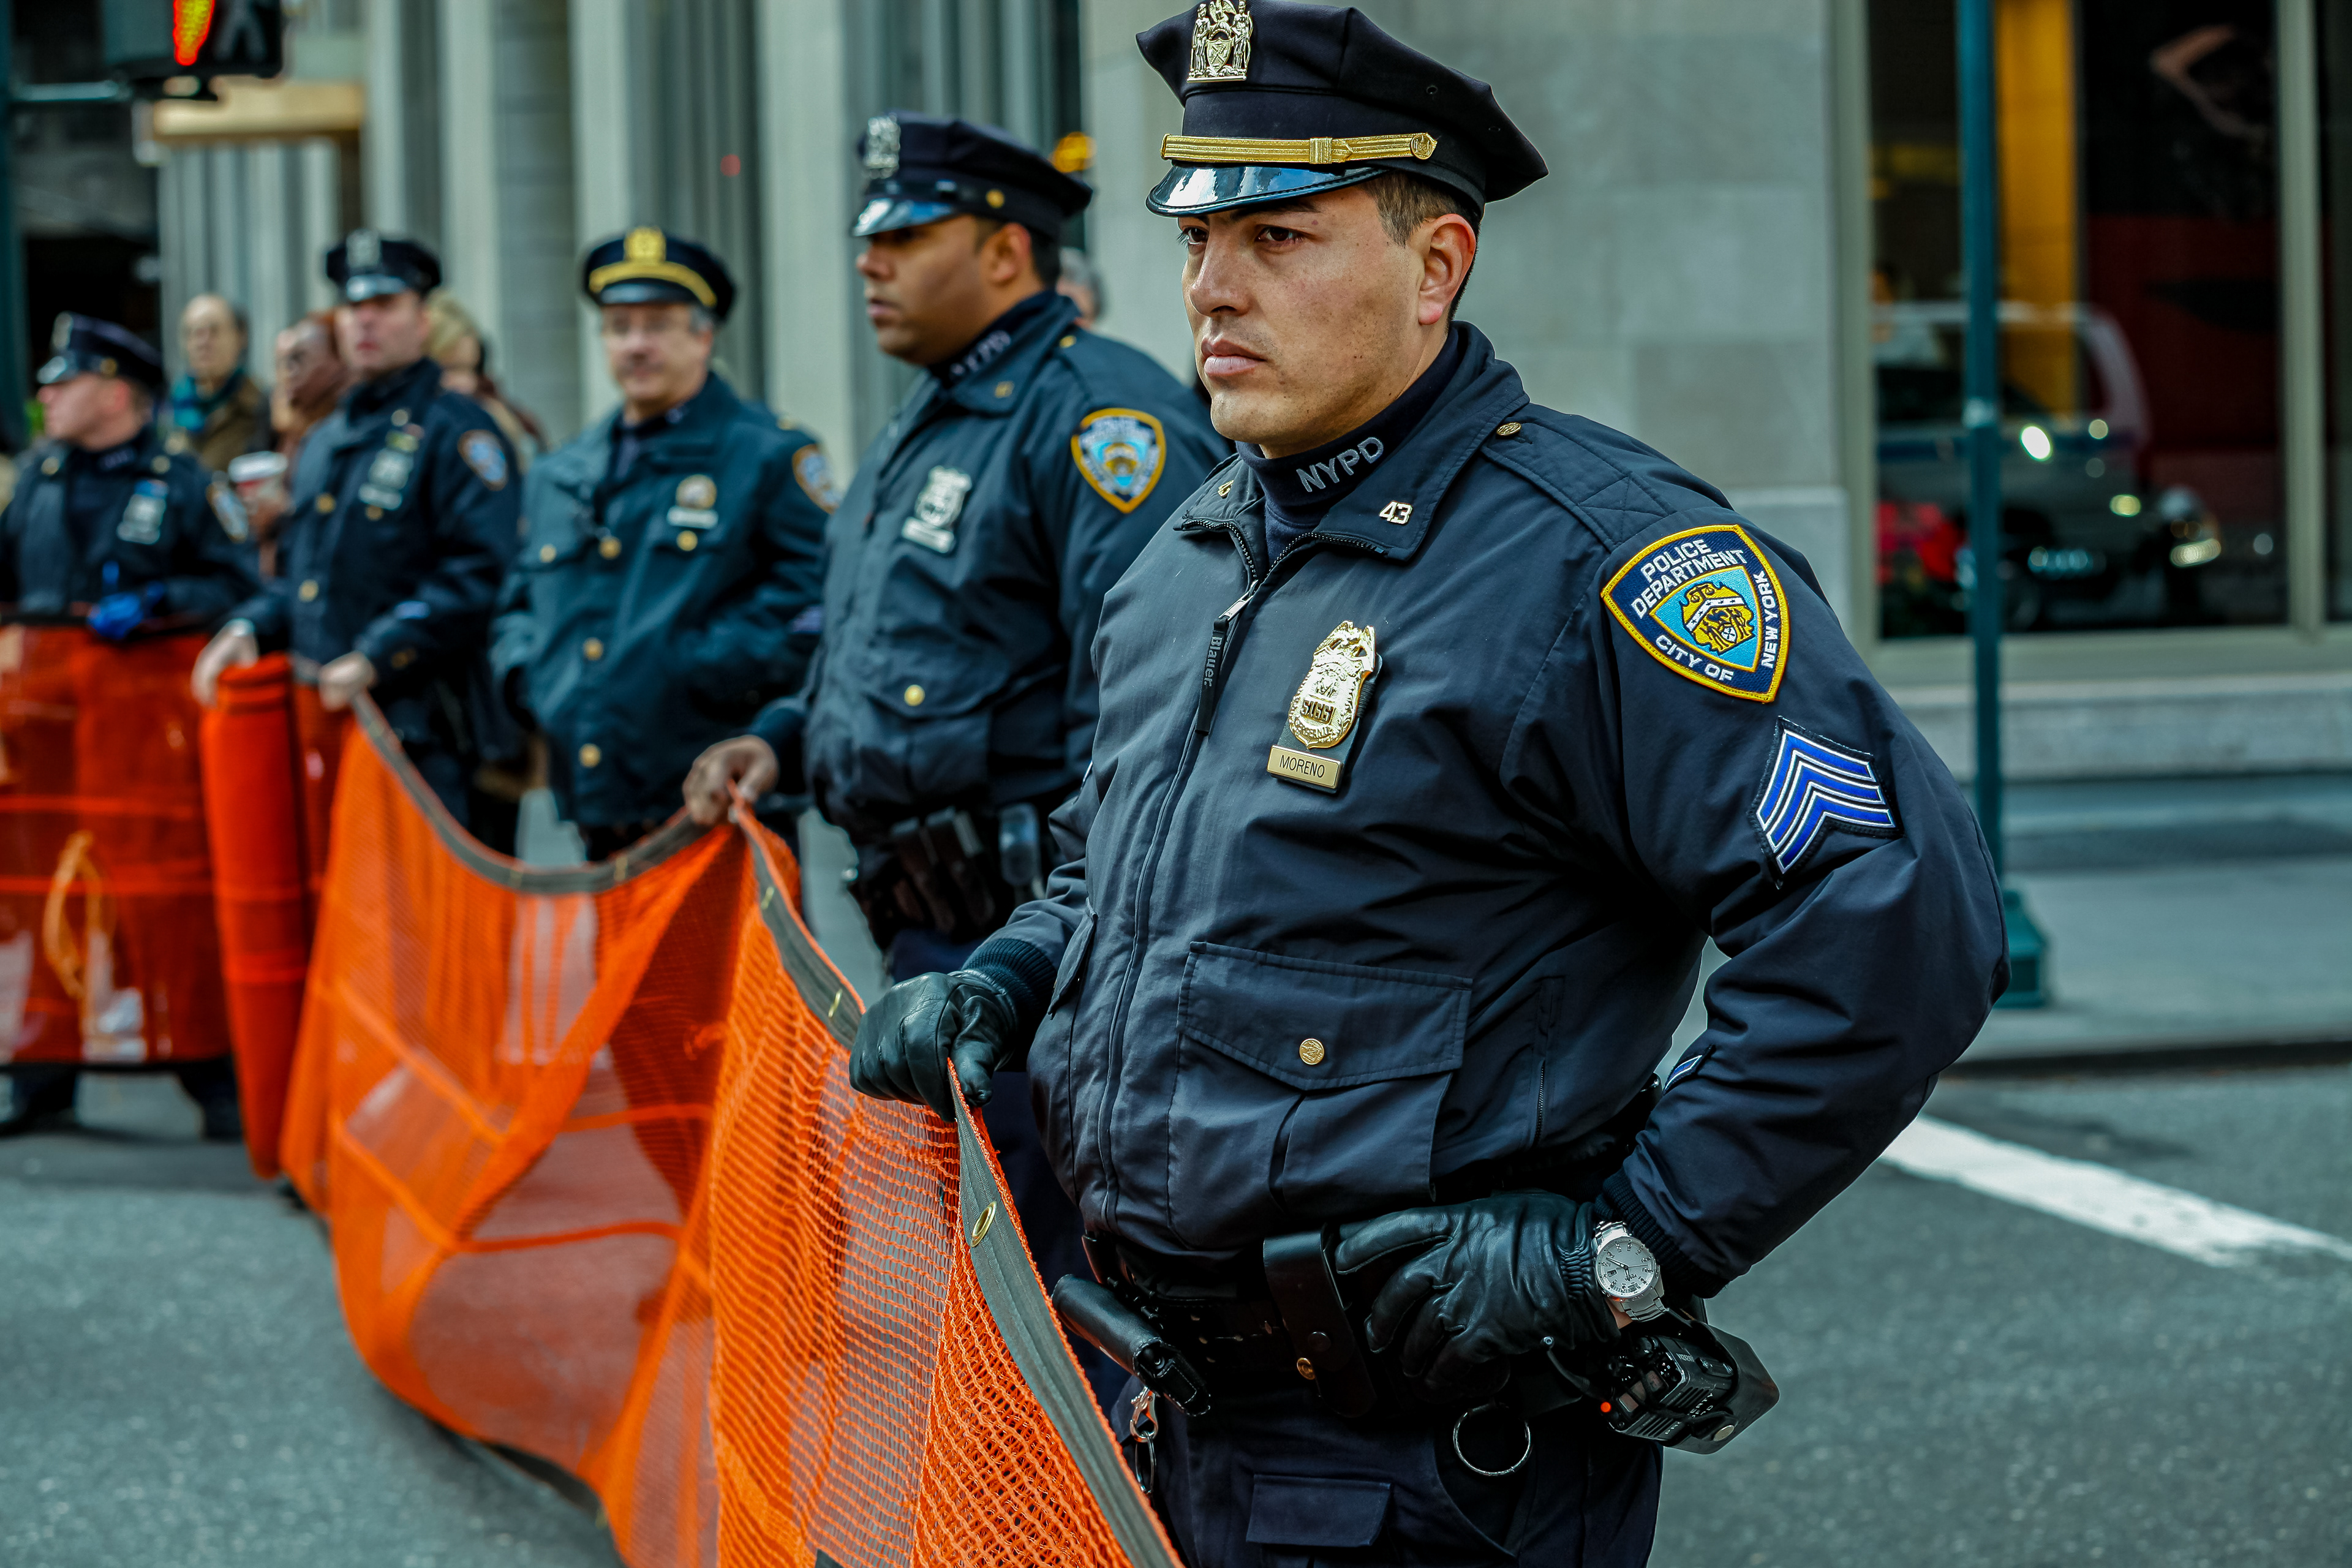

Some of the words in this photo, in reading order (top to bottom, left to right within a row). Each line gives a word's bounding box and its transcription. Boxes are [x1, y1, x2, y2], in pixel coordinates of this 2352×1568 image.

[1296, 437, 1384, 492] NYPD
[1379, 500, 1414, 524] 43
[1640, 539, 1712, 582] POLICE
[1631, 549, 1747, 619] DEPARTMENT
[1753, 570, 1777, 622] YORK
[1655, 635, 1704, 668] CITY
[1705, 664, 1734, 682] OF
[1761, 625, 1777, 668] NEW
[1279, 755, 1325, 778] MORENO
[1665, 1393, 1713, 1434] PRERTY
